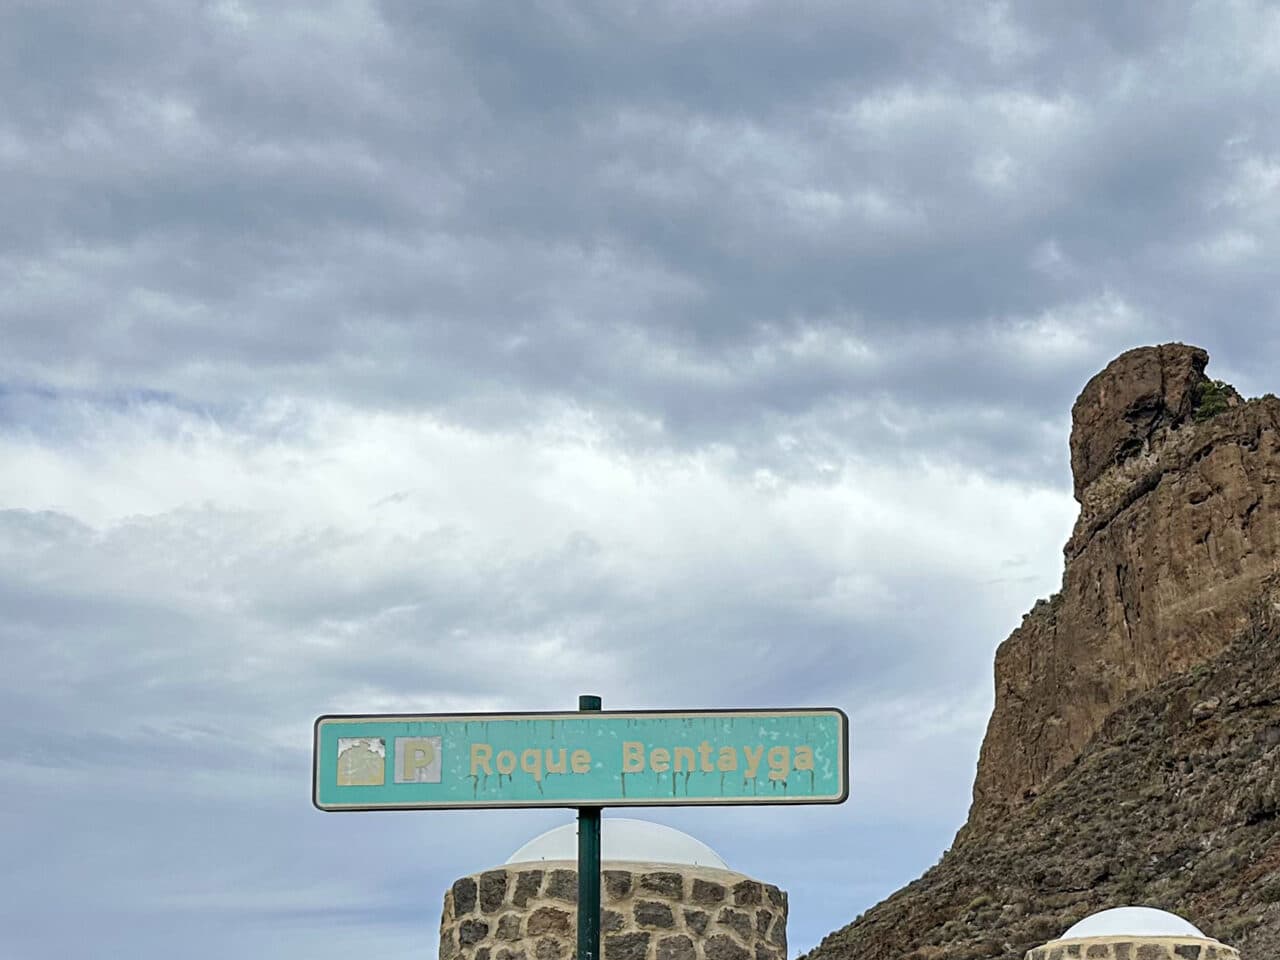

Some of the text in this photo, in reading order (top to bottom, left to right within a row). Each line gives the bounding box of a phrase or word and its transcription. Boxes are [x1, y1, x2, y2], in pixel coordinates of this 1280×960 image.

[404, 740, 814, 781] P Roque Bentayga
